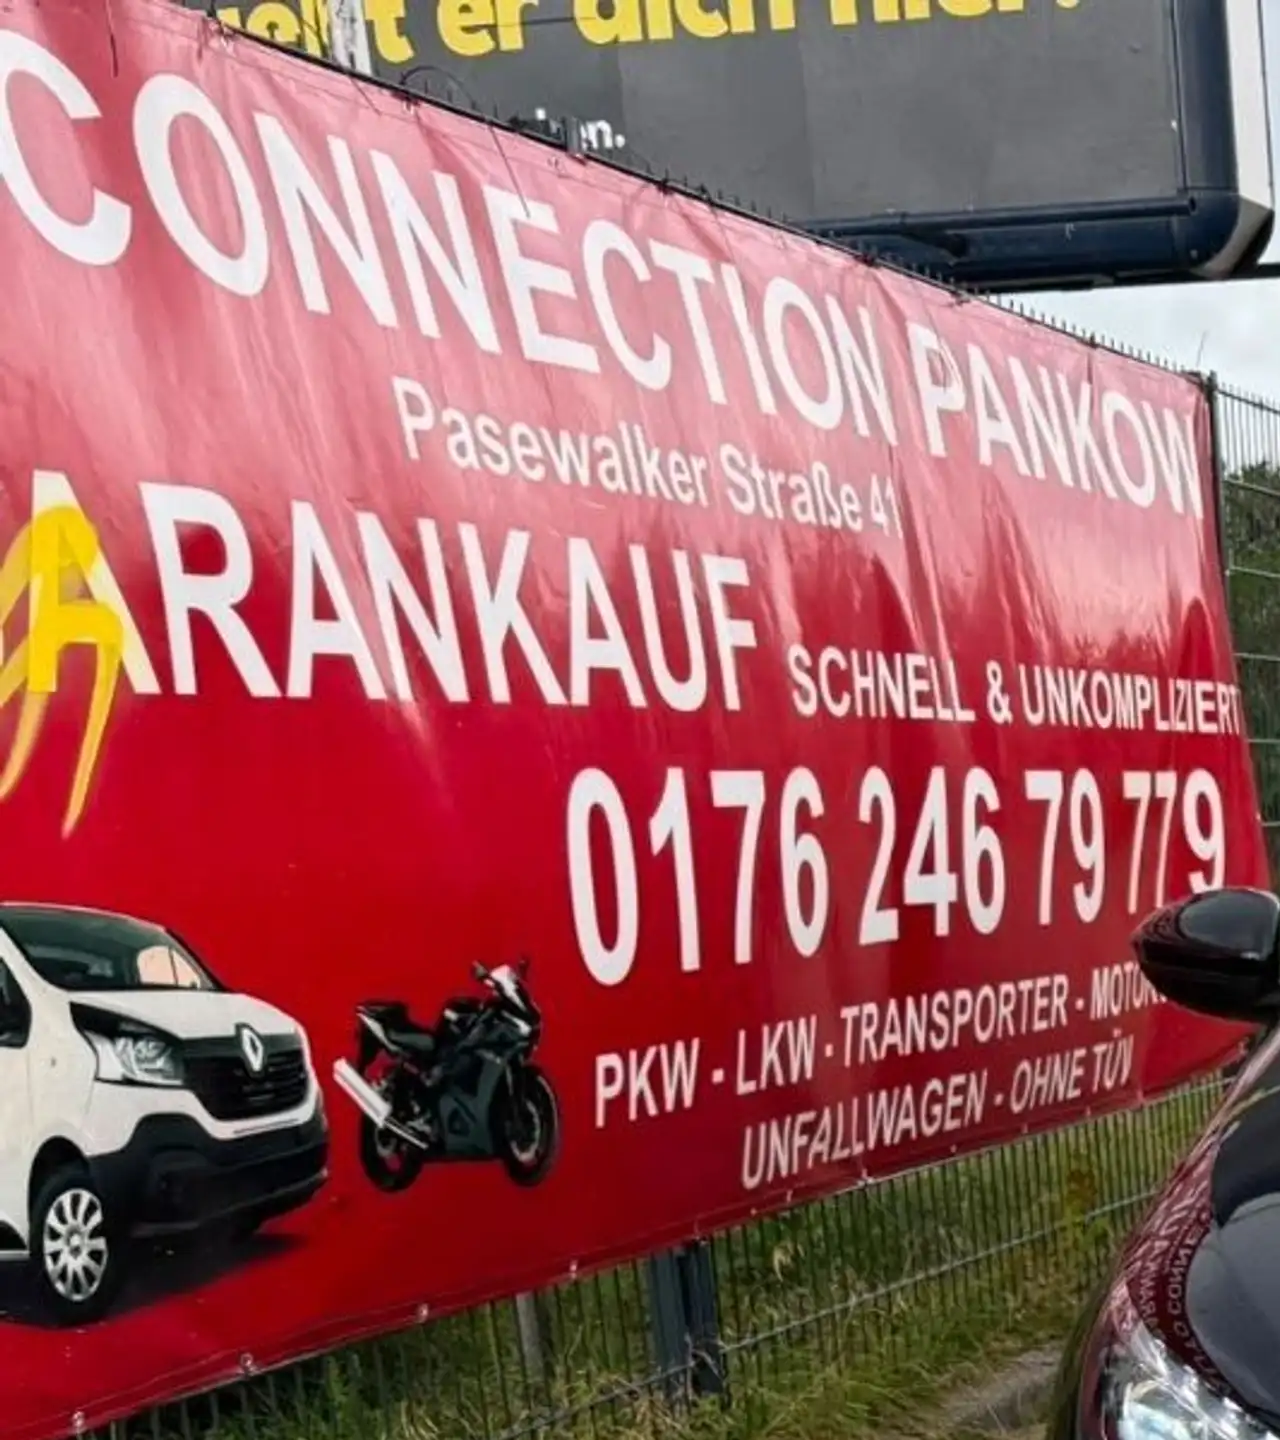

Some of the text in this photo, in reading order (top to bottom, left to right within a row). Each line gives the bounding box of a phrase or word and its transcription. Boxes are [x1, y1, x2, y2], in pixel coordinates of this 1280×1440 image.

[0, 28, 1203, 520] CONNECTION PANKOW
[392, 375, 903, 540] Pasewalker Straße 41
[0, 468, 1242, 736] ARANKAUF SCHNELL & UNKOMPLIZIERT
[566, 766, 1226, 986] 0176 246 79 779
[595, 1036, 700, 1129] PKW
[736, 1013, 818, 1096] LKW
[840, 973, 1069, 1069] TRANSPORTER
[741, 1068, 988, 1190] UNFALLWAGEN
[1010, 1042, 1087, 1115] OHNE
[1093, 1027, 1135, 1094] TÜV
